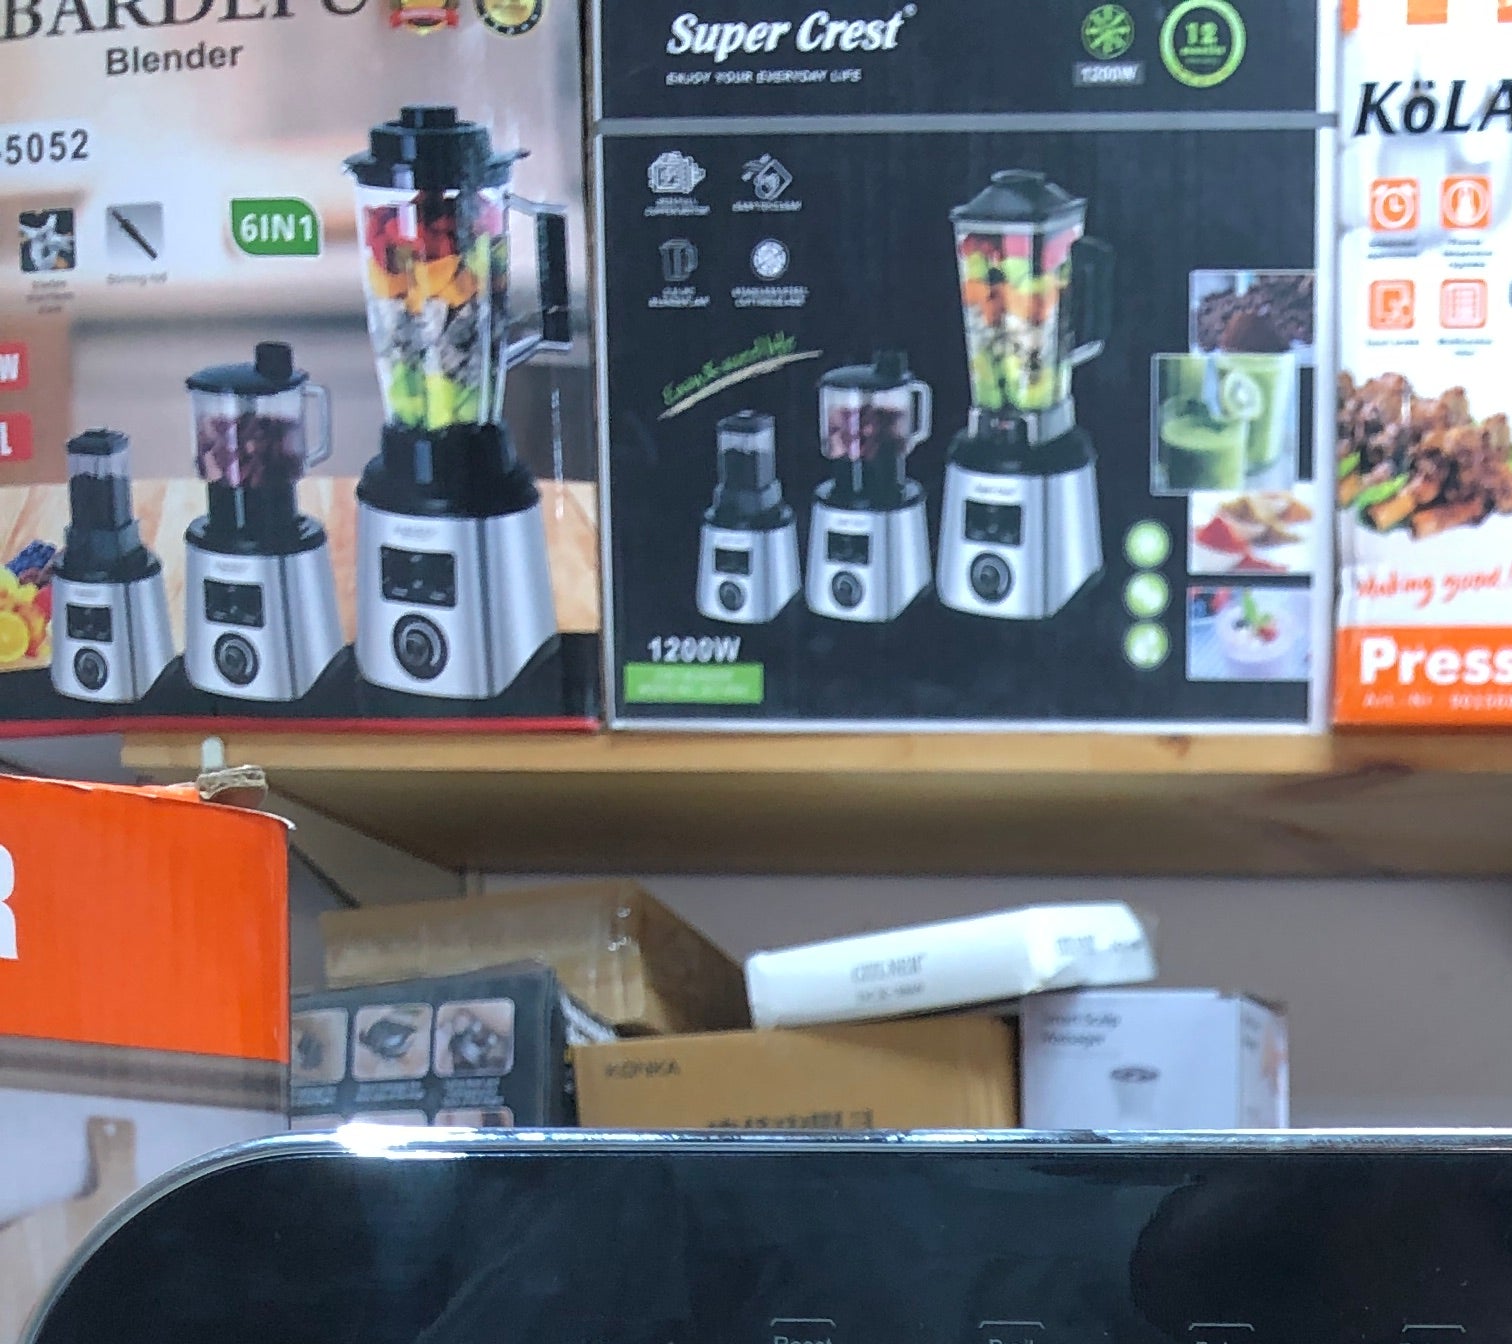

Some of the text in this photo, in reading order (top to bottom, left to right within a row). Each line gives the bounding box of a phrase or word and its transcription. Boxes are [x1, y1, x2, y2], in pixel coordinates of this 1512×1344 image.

[666, 12, 792, 63] Super
[1186, 22, 1218, 45] 12
[106, 42, 244, 75] Blender
[240, 213, 313, 244] 6IN1
[647, 636, 741, 662] 1200W
